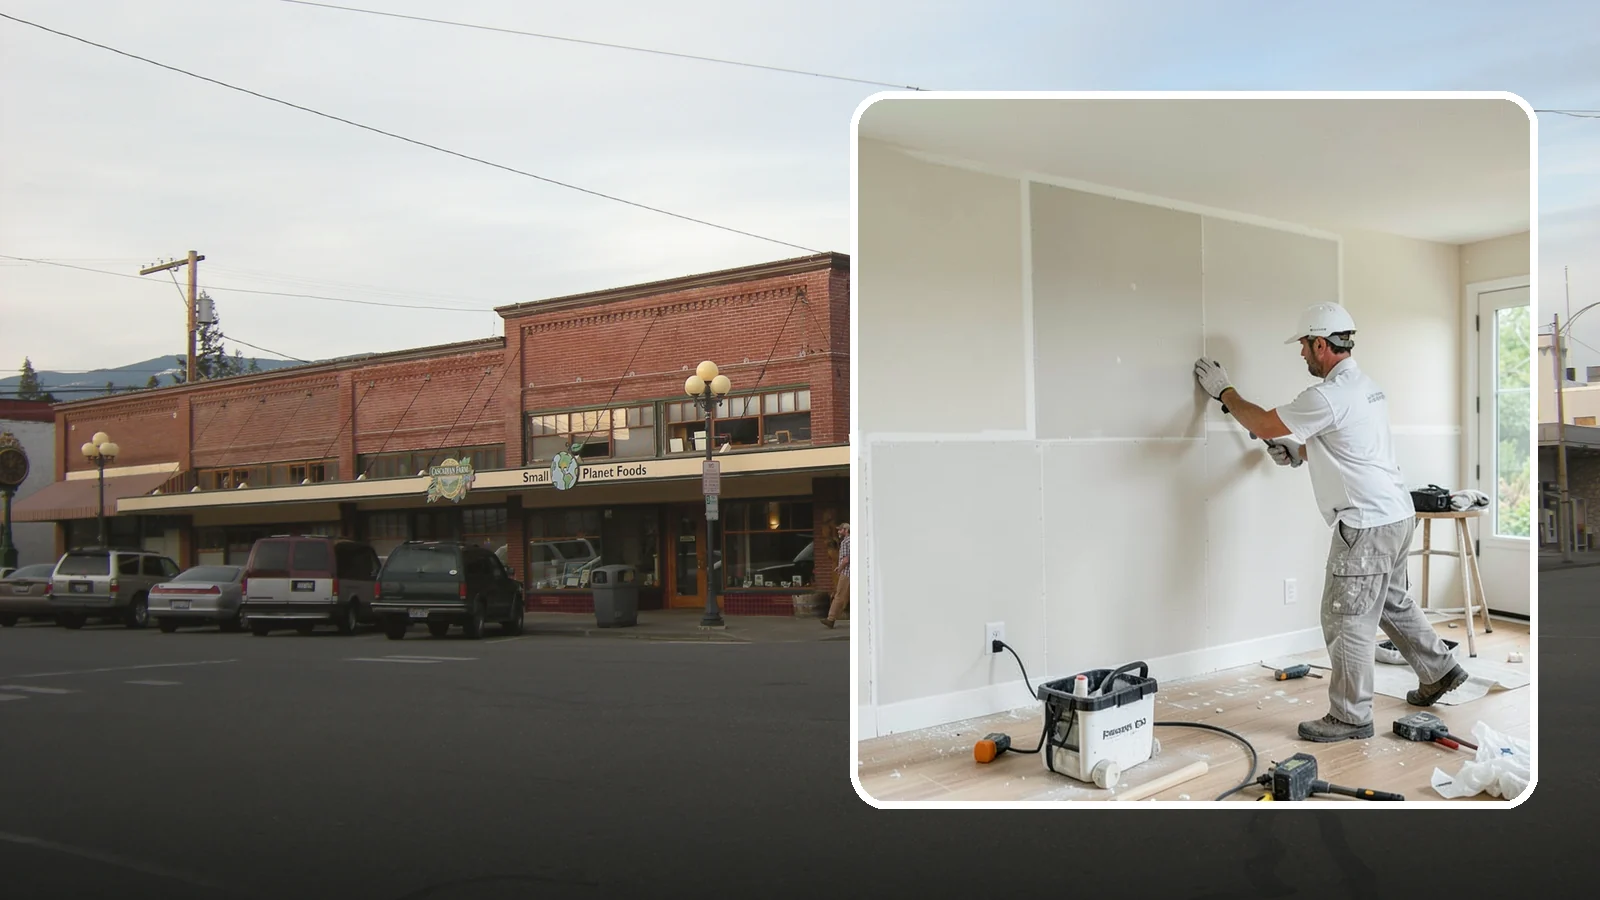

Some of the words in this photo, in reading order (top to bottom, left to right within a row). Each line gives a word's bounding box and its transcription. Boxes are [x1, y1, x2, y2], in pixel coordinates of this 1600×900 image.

[522, 470, 549, 483] Small
[582, 467, 614, 479] Planet
[617, 464, 647, 477] Foods
